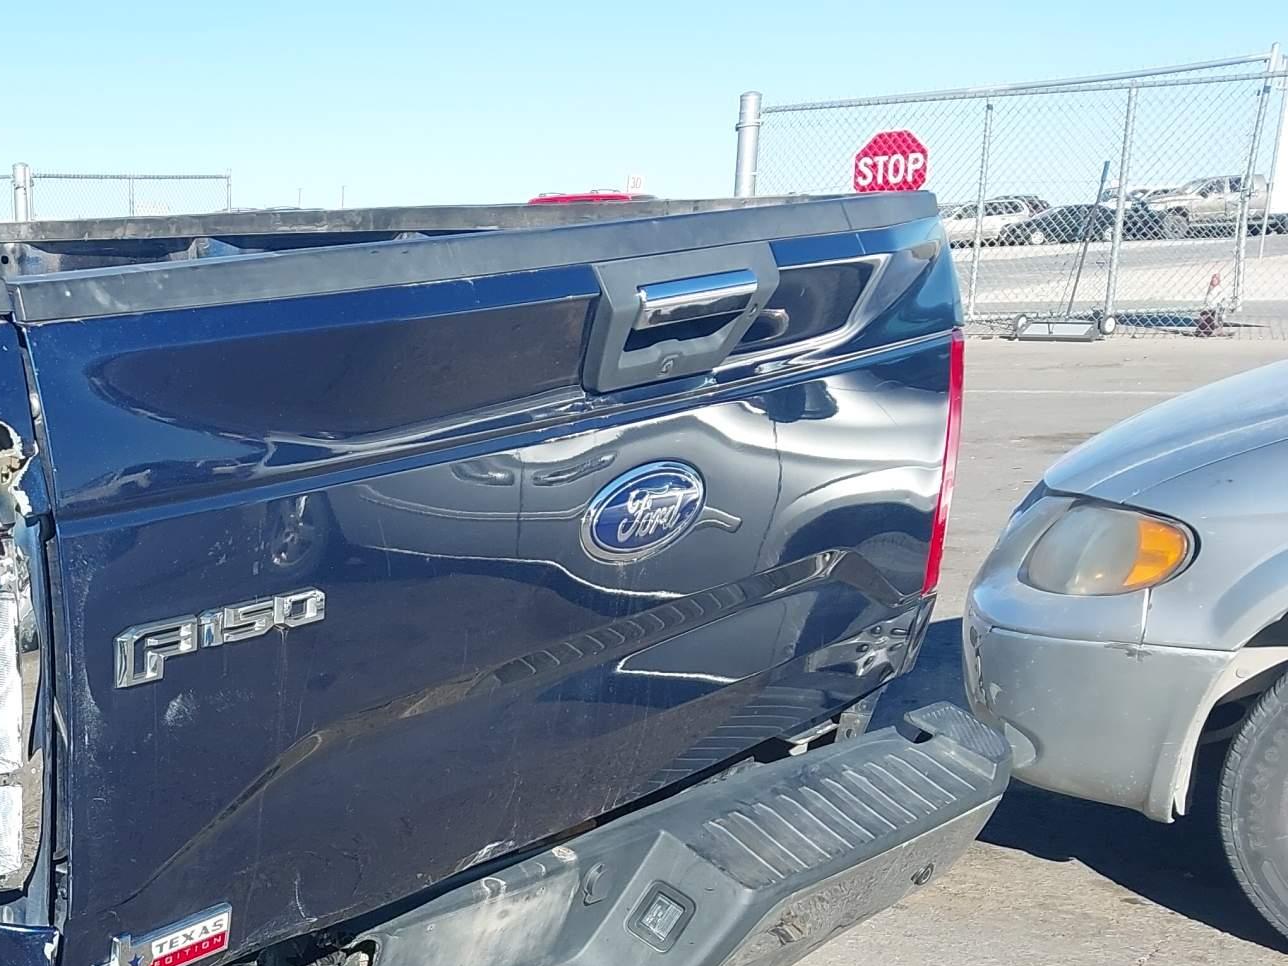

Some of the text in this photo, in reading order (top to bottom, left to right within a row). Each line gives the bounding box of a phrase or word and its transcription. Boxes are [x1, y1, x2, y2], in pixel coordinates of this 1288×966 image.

[857, 152, 924, 187] STOP
[616, 486, 684, 543] Ford
[155, 918, 224, 954] TEXAS
